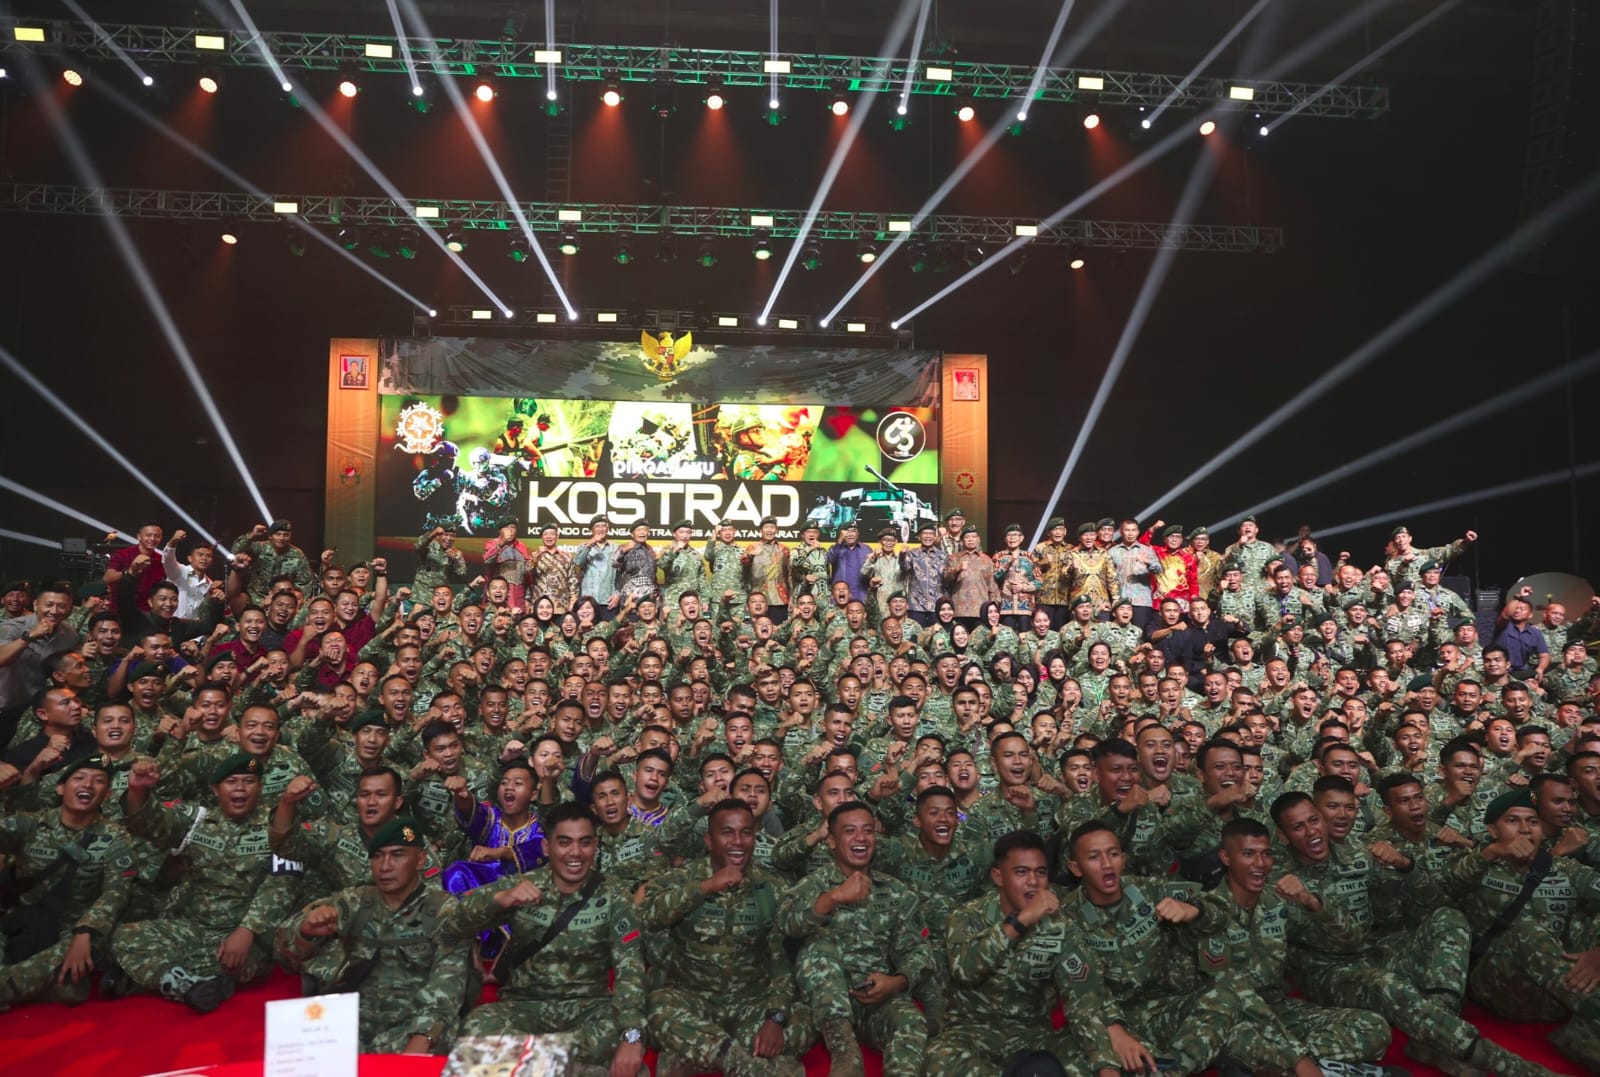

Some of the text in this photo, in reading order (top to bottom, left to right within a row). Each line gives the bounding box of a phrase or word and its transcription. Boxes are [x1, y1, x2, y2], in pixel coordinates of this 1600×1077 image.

[528, 480, 799, 527] KOSTRAD
[1339, 883, 1355, 892] TNI
[573, 916, 592, 925] TNI
[1129, 926, 1148, 941] TNI
[1263, 925, 1282, 935] TNI
[1026, 952, 1044, 962] TNI
